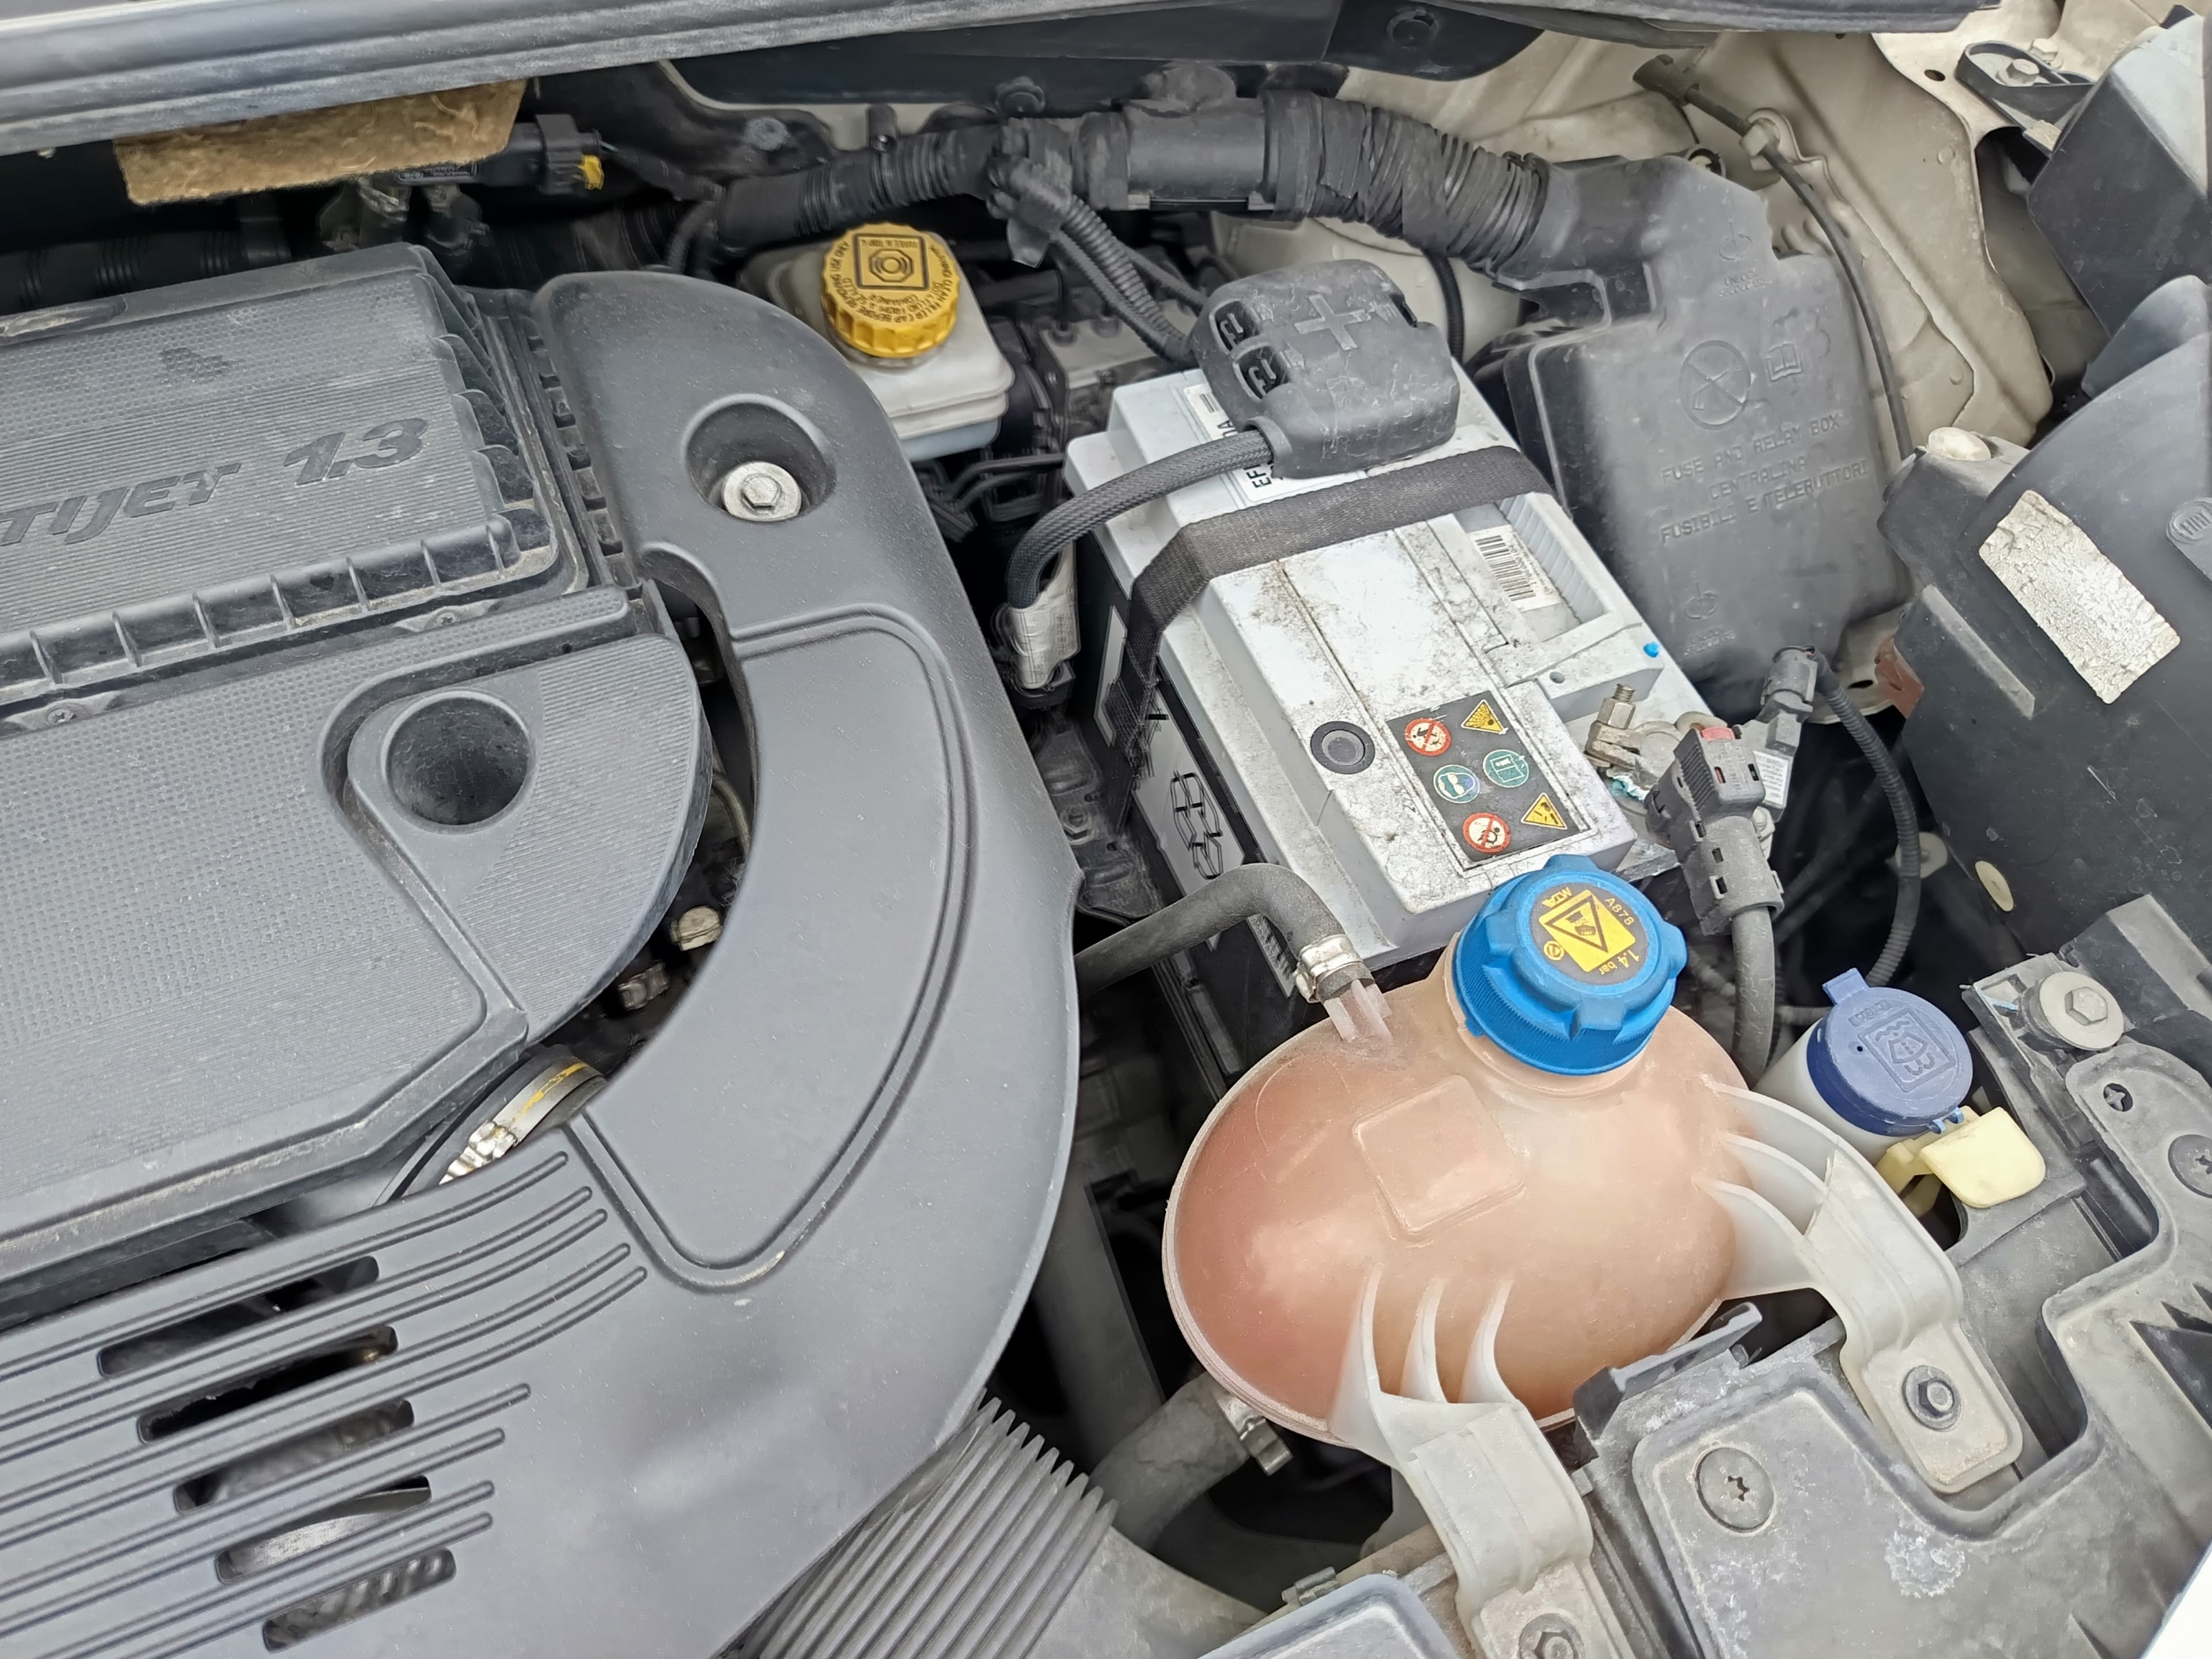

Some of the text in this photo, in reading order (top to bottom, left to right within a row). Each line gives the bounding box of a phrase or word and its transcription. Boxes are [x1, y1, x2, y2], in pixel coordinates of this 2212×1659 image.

[893, 315, 915, 323] CAP
[1660, 414, 1840, 484] FUSE AND RELAY BOX
[1709, 455, 1806, 501] CENTRALINA
[1660, 459, 1868, 544] FUSIBILI E TELERUTTORI
[2179, 511, 2211, 536] FIAT
[1541, 887, 1572, 908] MTA
[1604, 897, 1634, 926] A878
[1599, 949, 1640, 975] 1.4 bar
